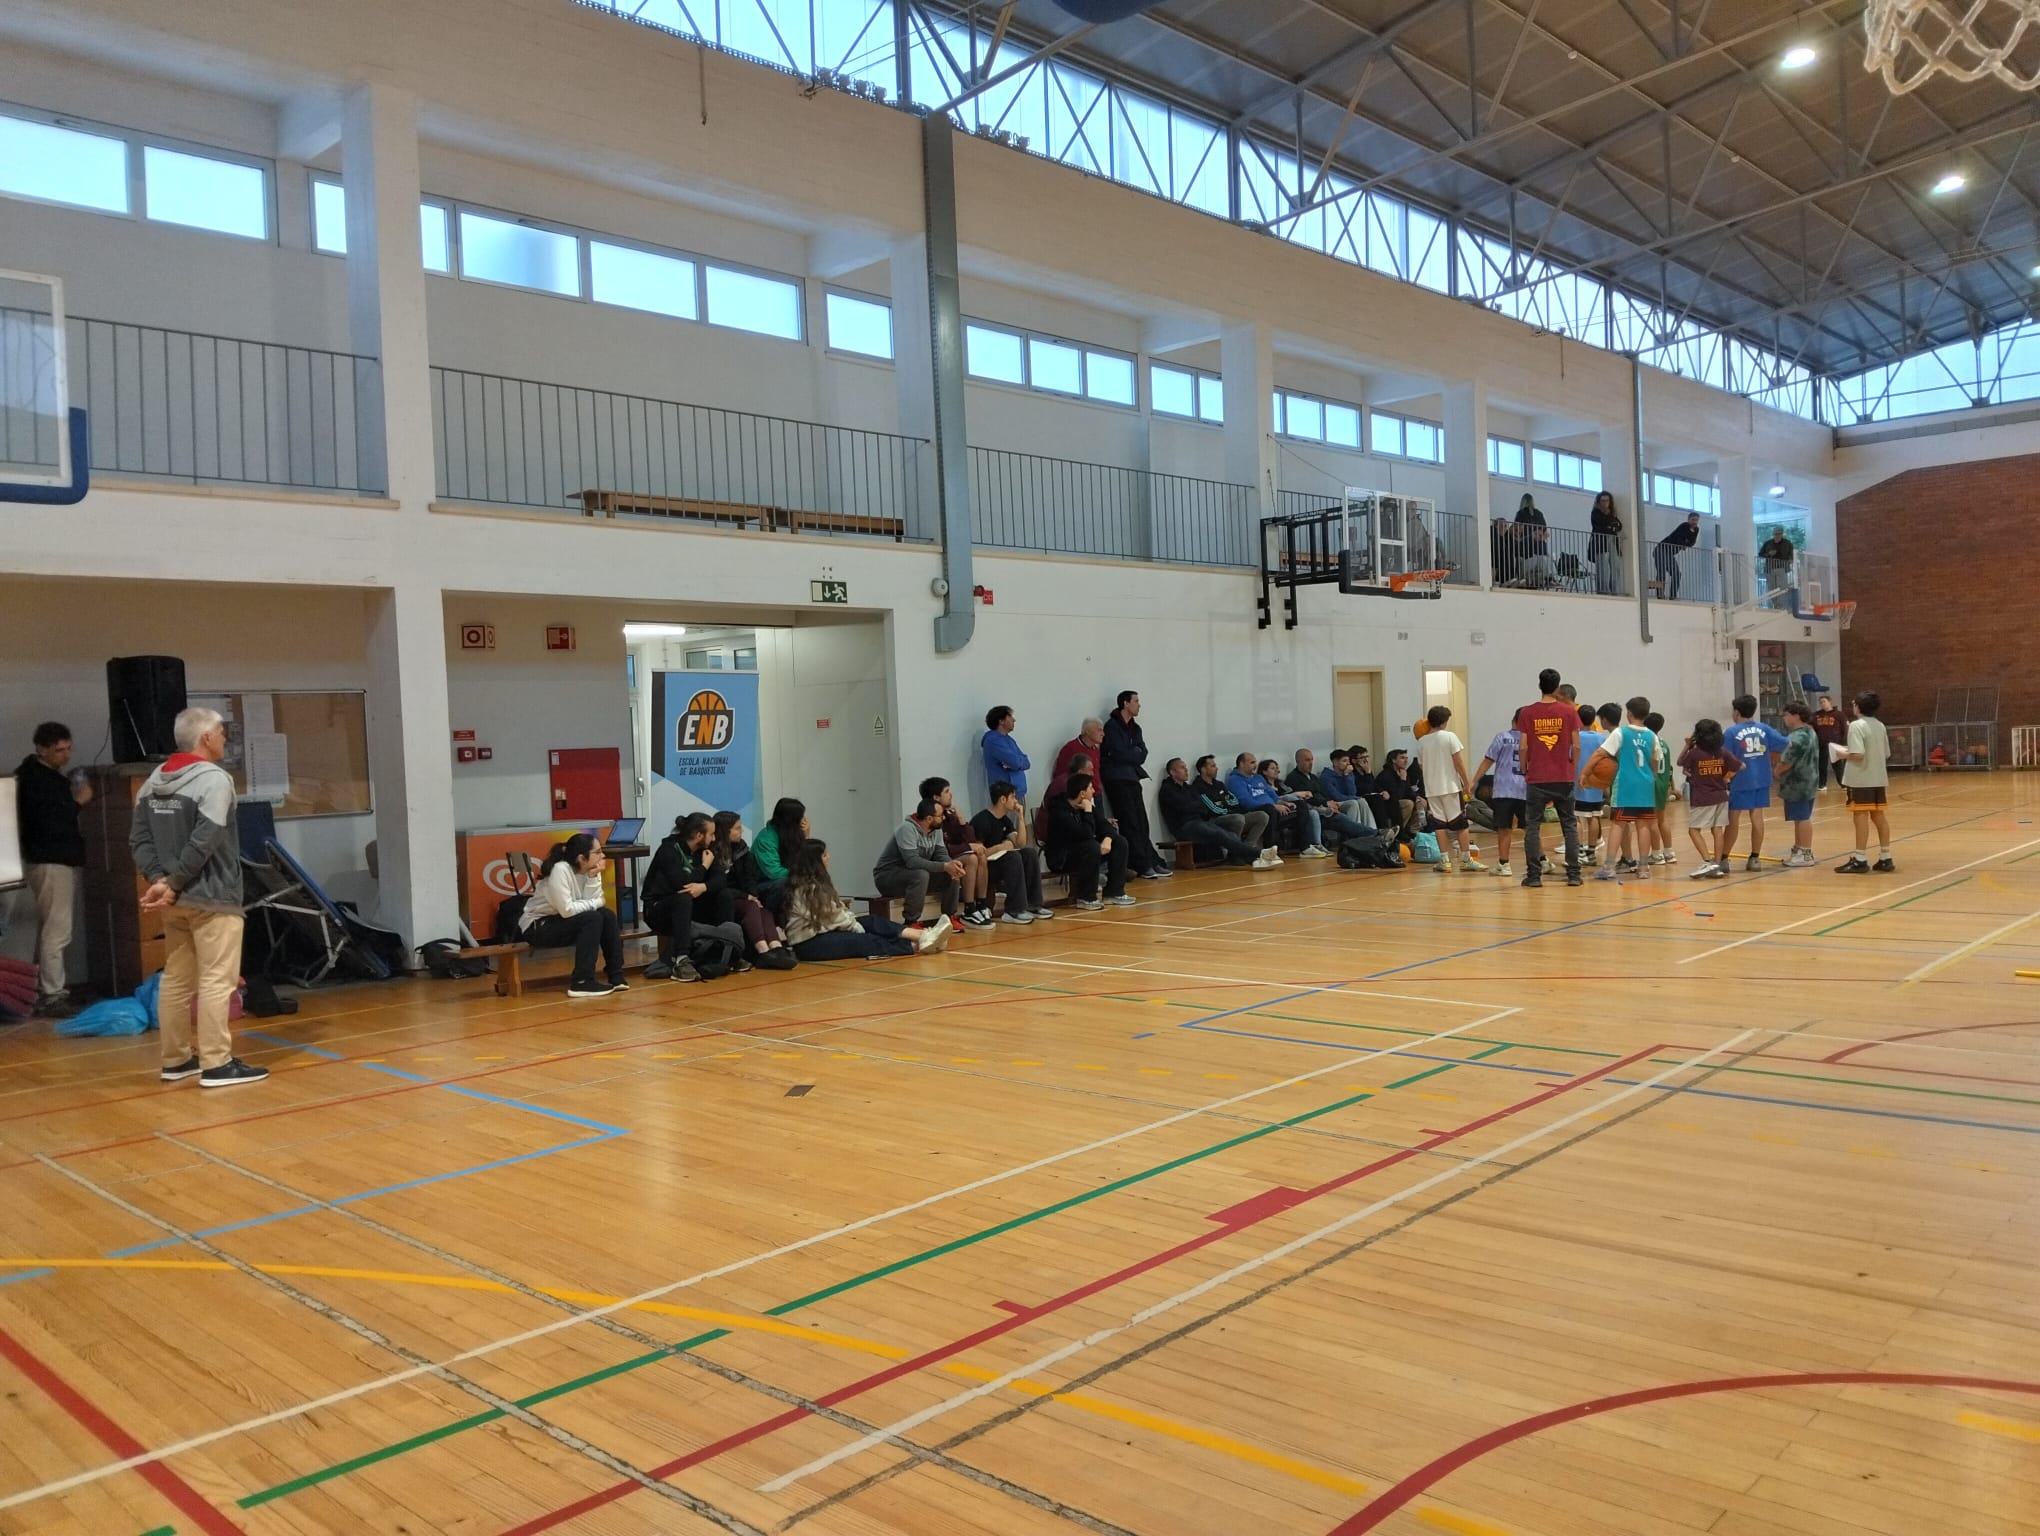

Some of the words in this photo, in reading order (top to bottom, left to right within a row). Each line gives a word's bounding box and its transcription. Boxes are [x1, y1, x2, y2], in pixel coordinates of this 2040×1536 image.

[1534, 718, 1563, 728] TORNEIO
[683, 714, 729, 746] ENB
[1745, 736, 1762, 752] 94
[679, 757, 699, 767] ESCOLA
[702, 756, 728, 766] NACIONAL
[680, 767, 687, 776] DE
[689, 766, 726, 776] BASQUETEBOL
